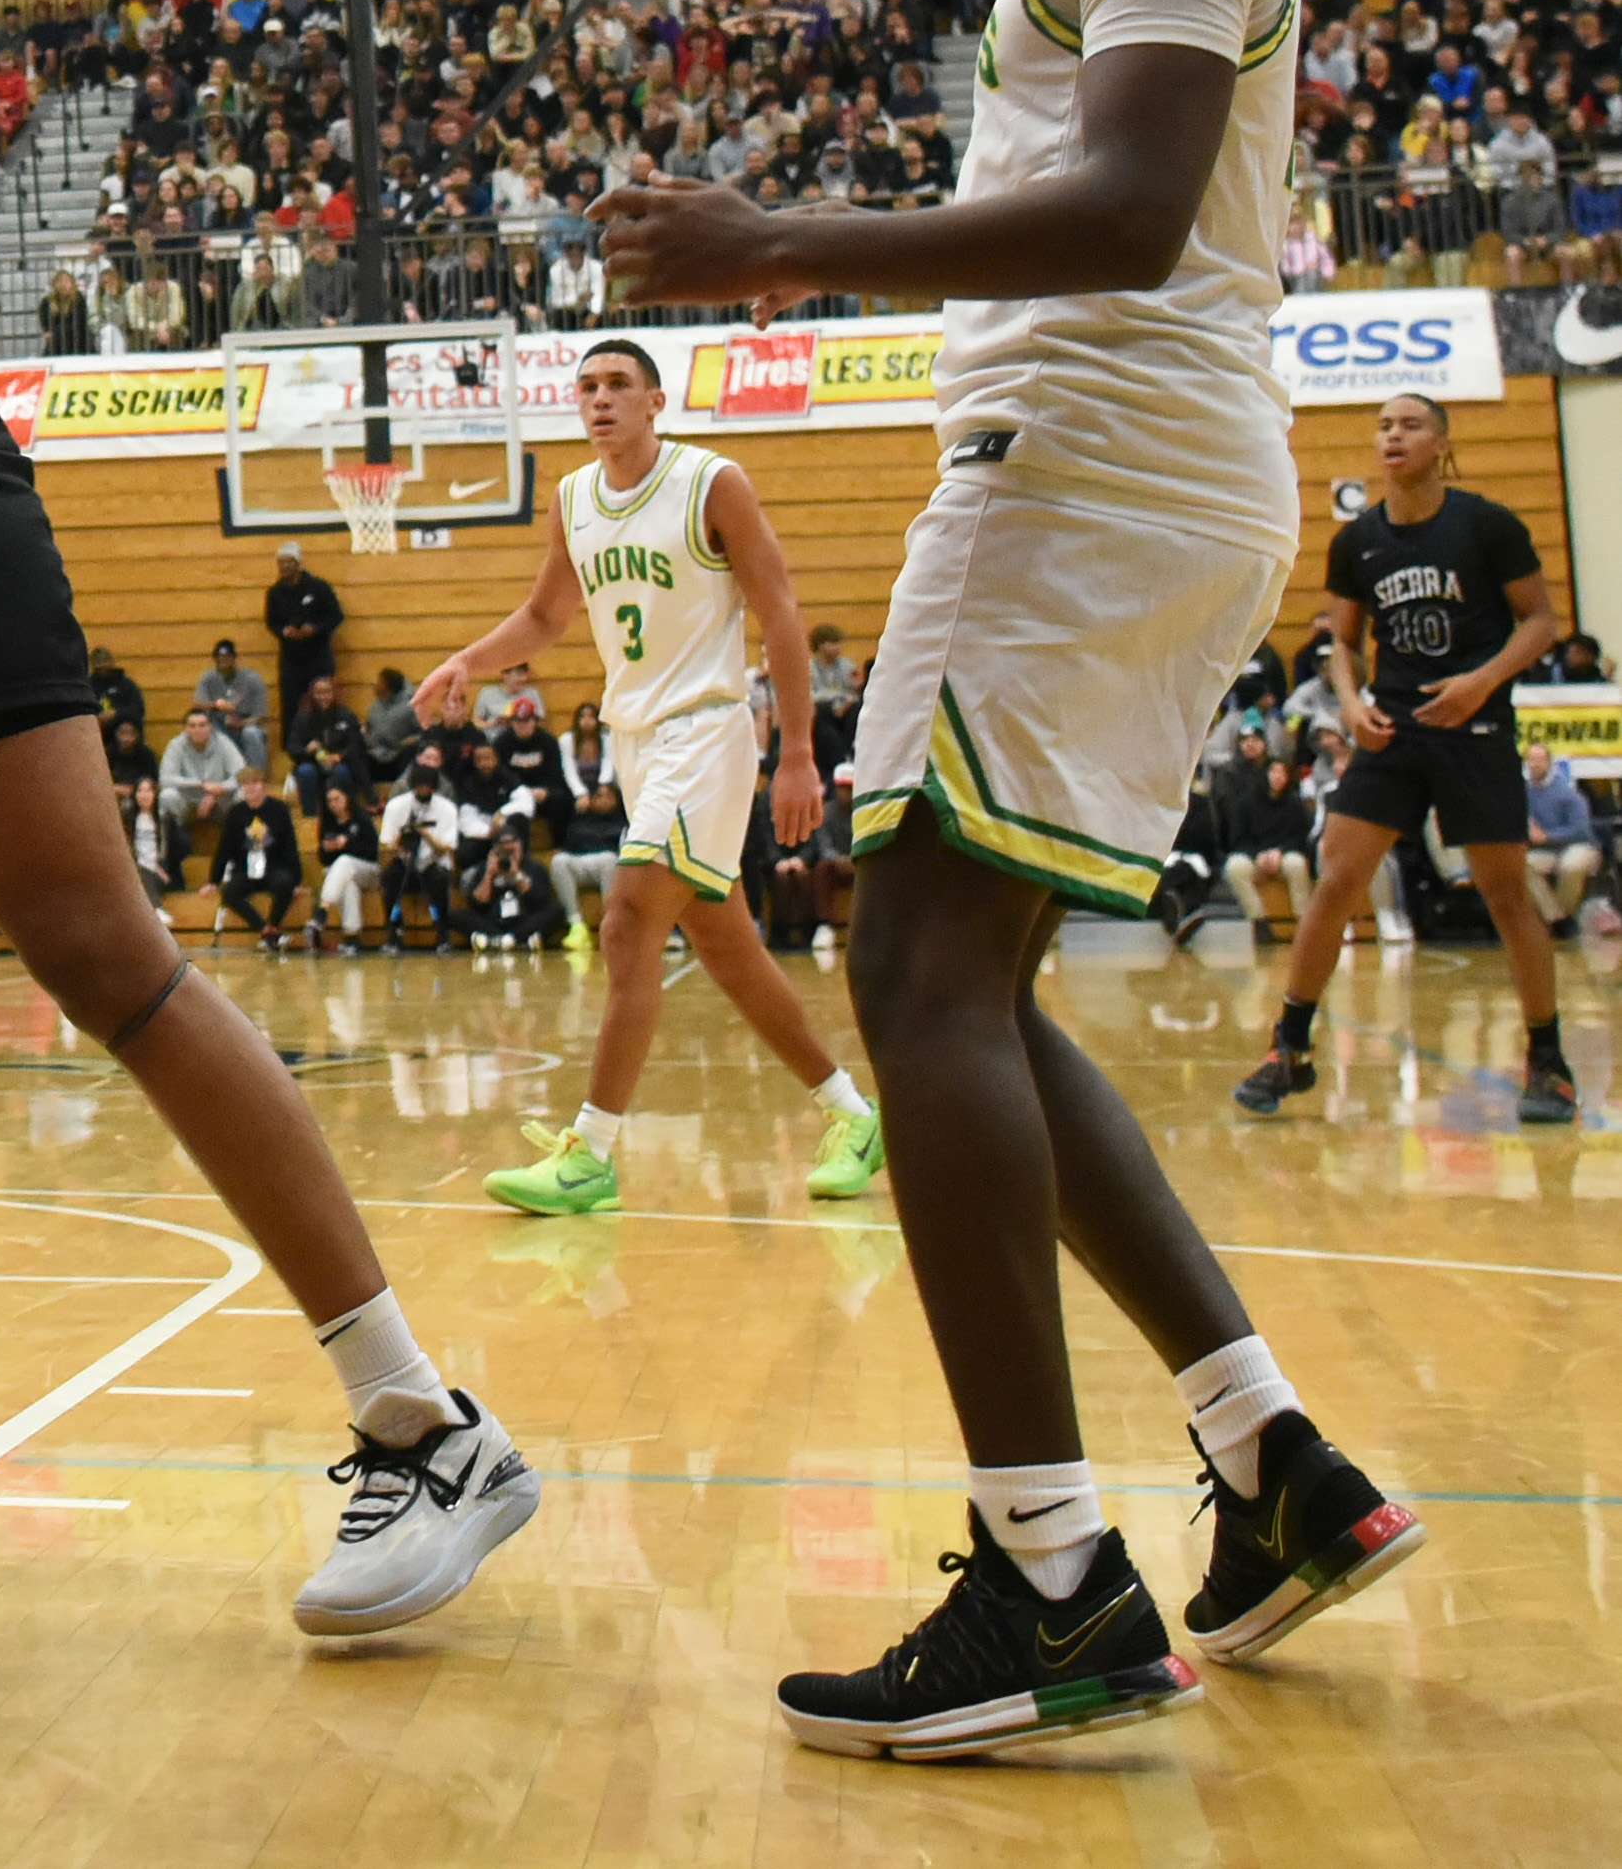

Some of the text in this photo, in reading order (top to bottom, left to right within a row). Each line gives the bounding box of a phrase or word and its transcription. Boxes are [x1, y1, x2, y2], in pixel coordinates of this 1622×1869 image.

[729, 346, 937, 396] Tires LES SC
[46, 389, 100, 420] LES
[579, 544, 675, 598] LIONS
[1373, 565, 1465, 610] SIERRA
[614, 602, 645, 663] 3
[1387, 607, 1451, 657] 10
